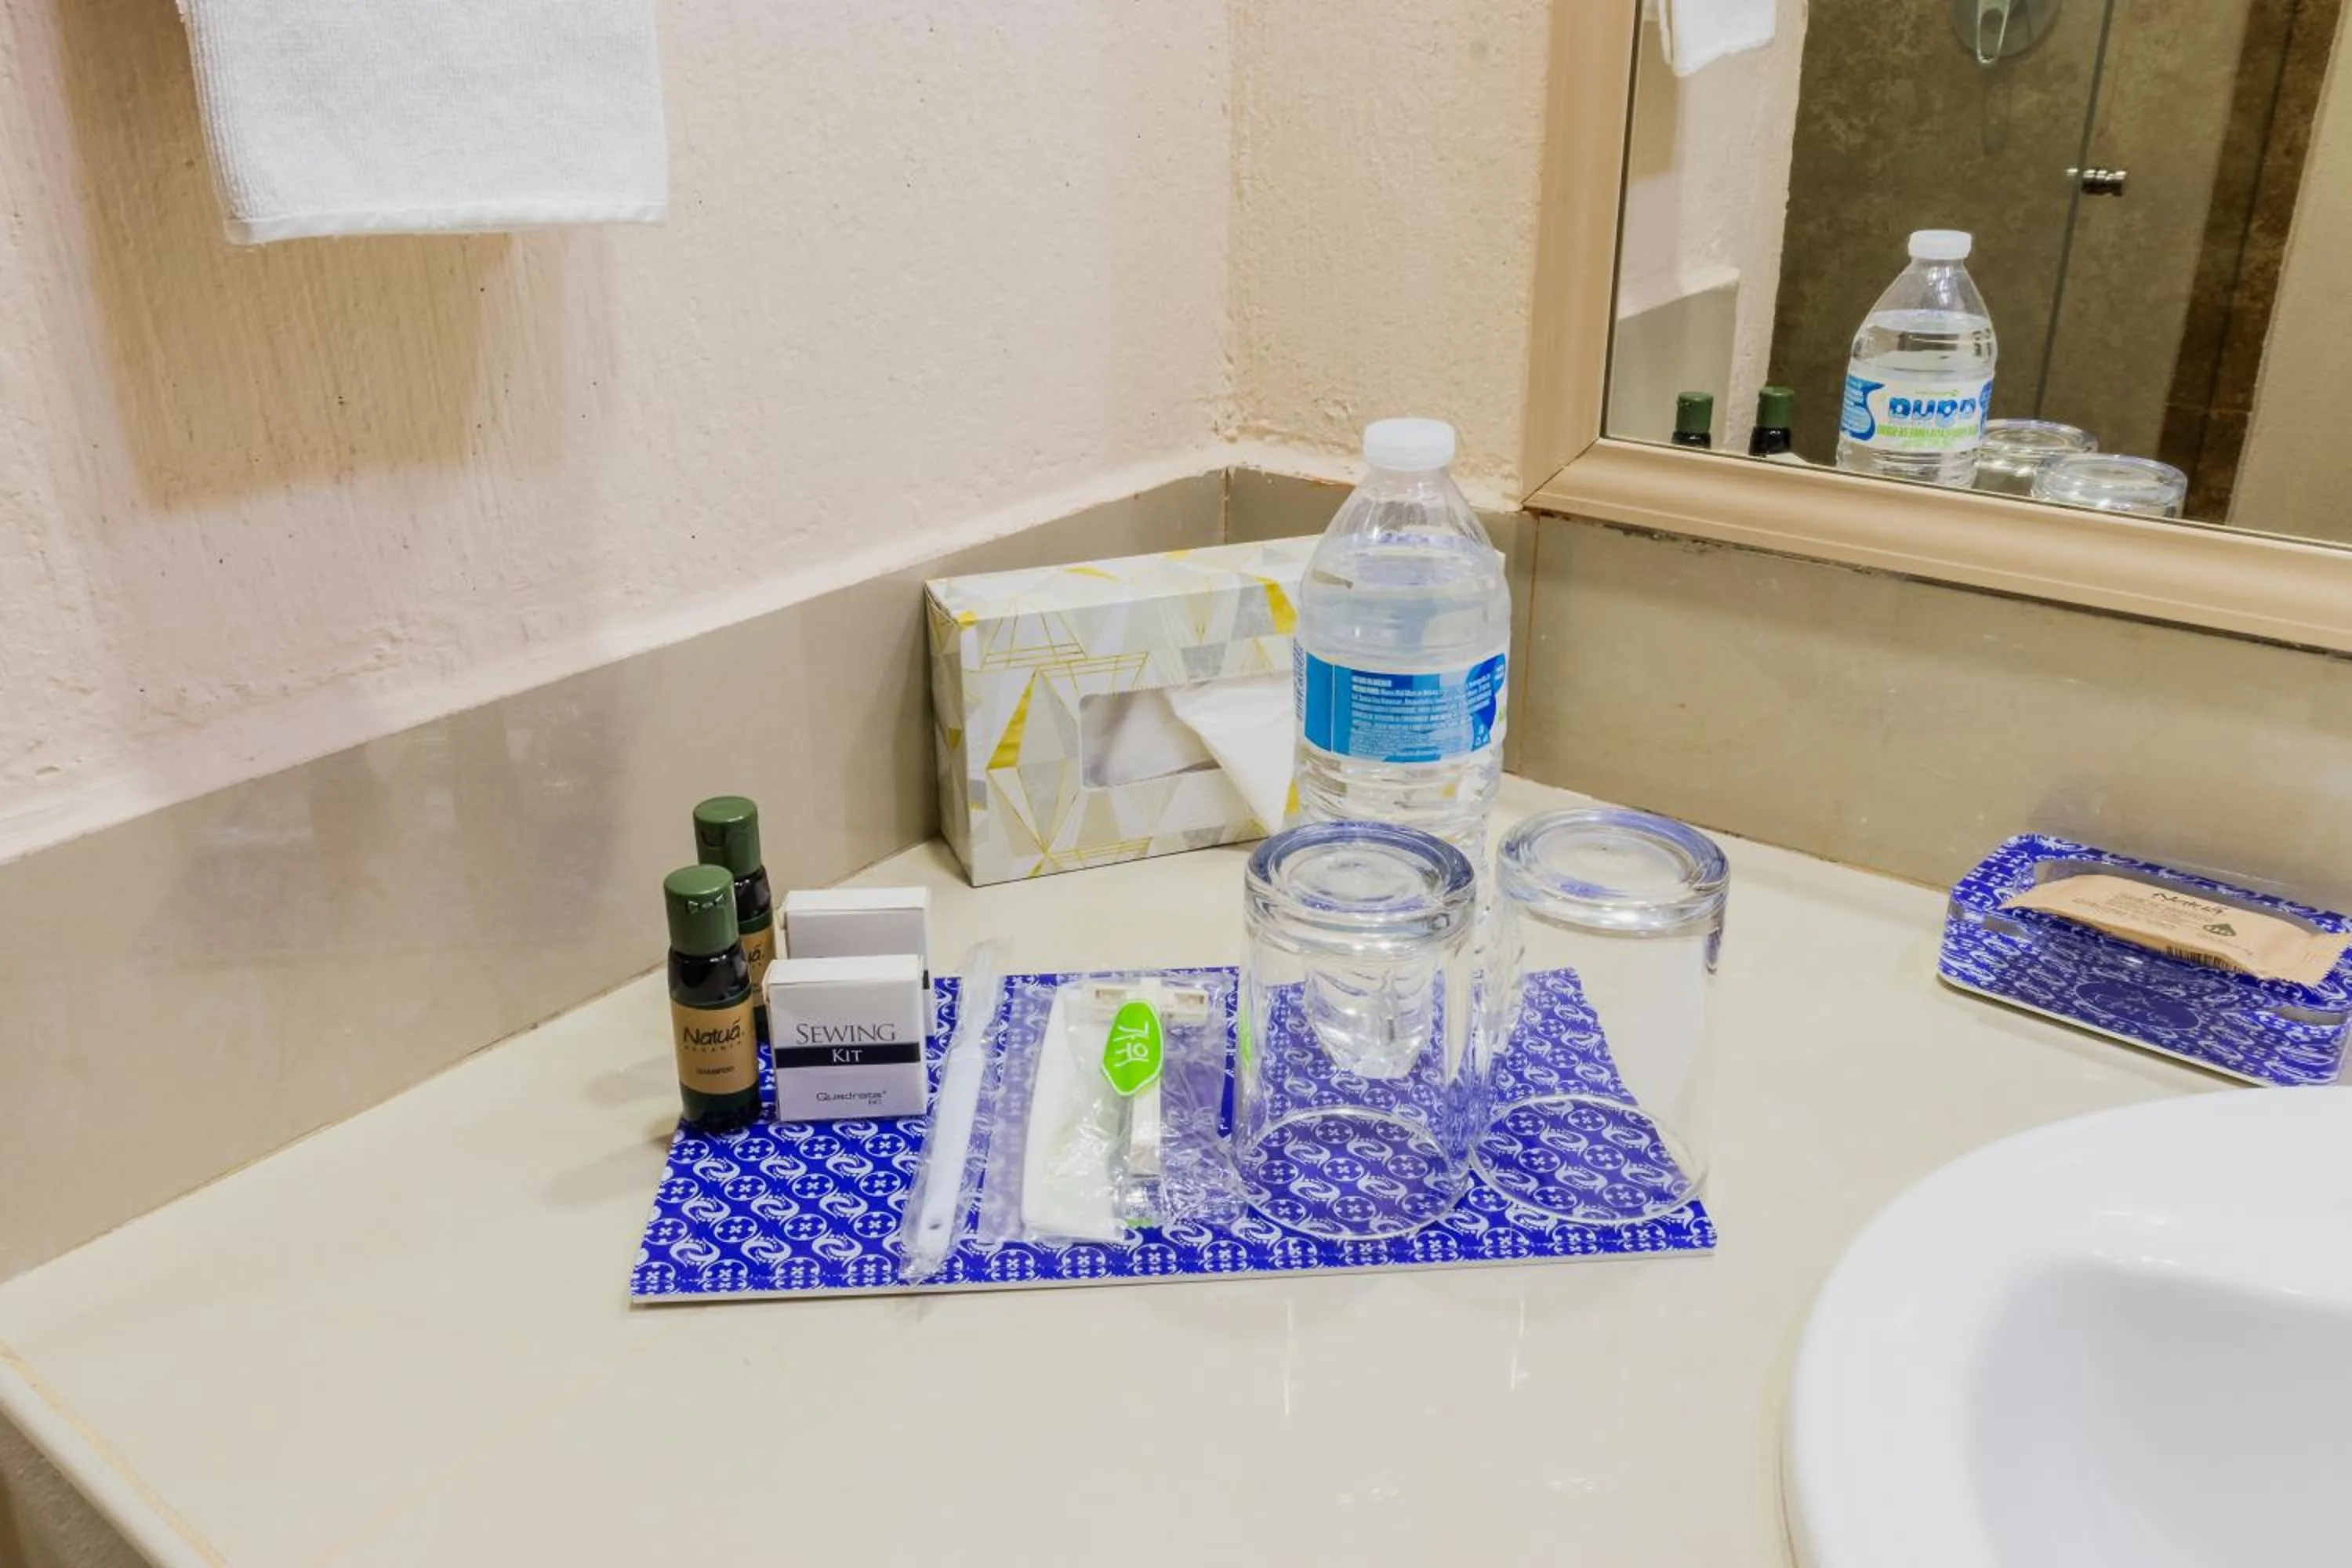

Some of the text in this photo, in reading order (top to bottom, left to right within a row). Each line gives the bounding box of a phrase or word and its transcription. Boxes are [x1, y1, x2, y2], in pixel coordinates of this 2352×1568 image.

[683, 1017, 741, 1045] Natuá
[796, 1022, 896, 1045] SEWING
[832, 1048, 862, 1063] KIT
